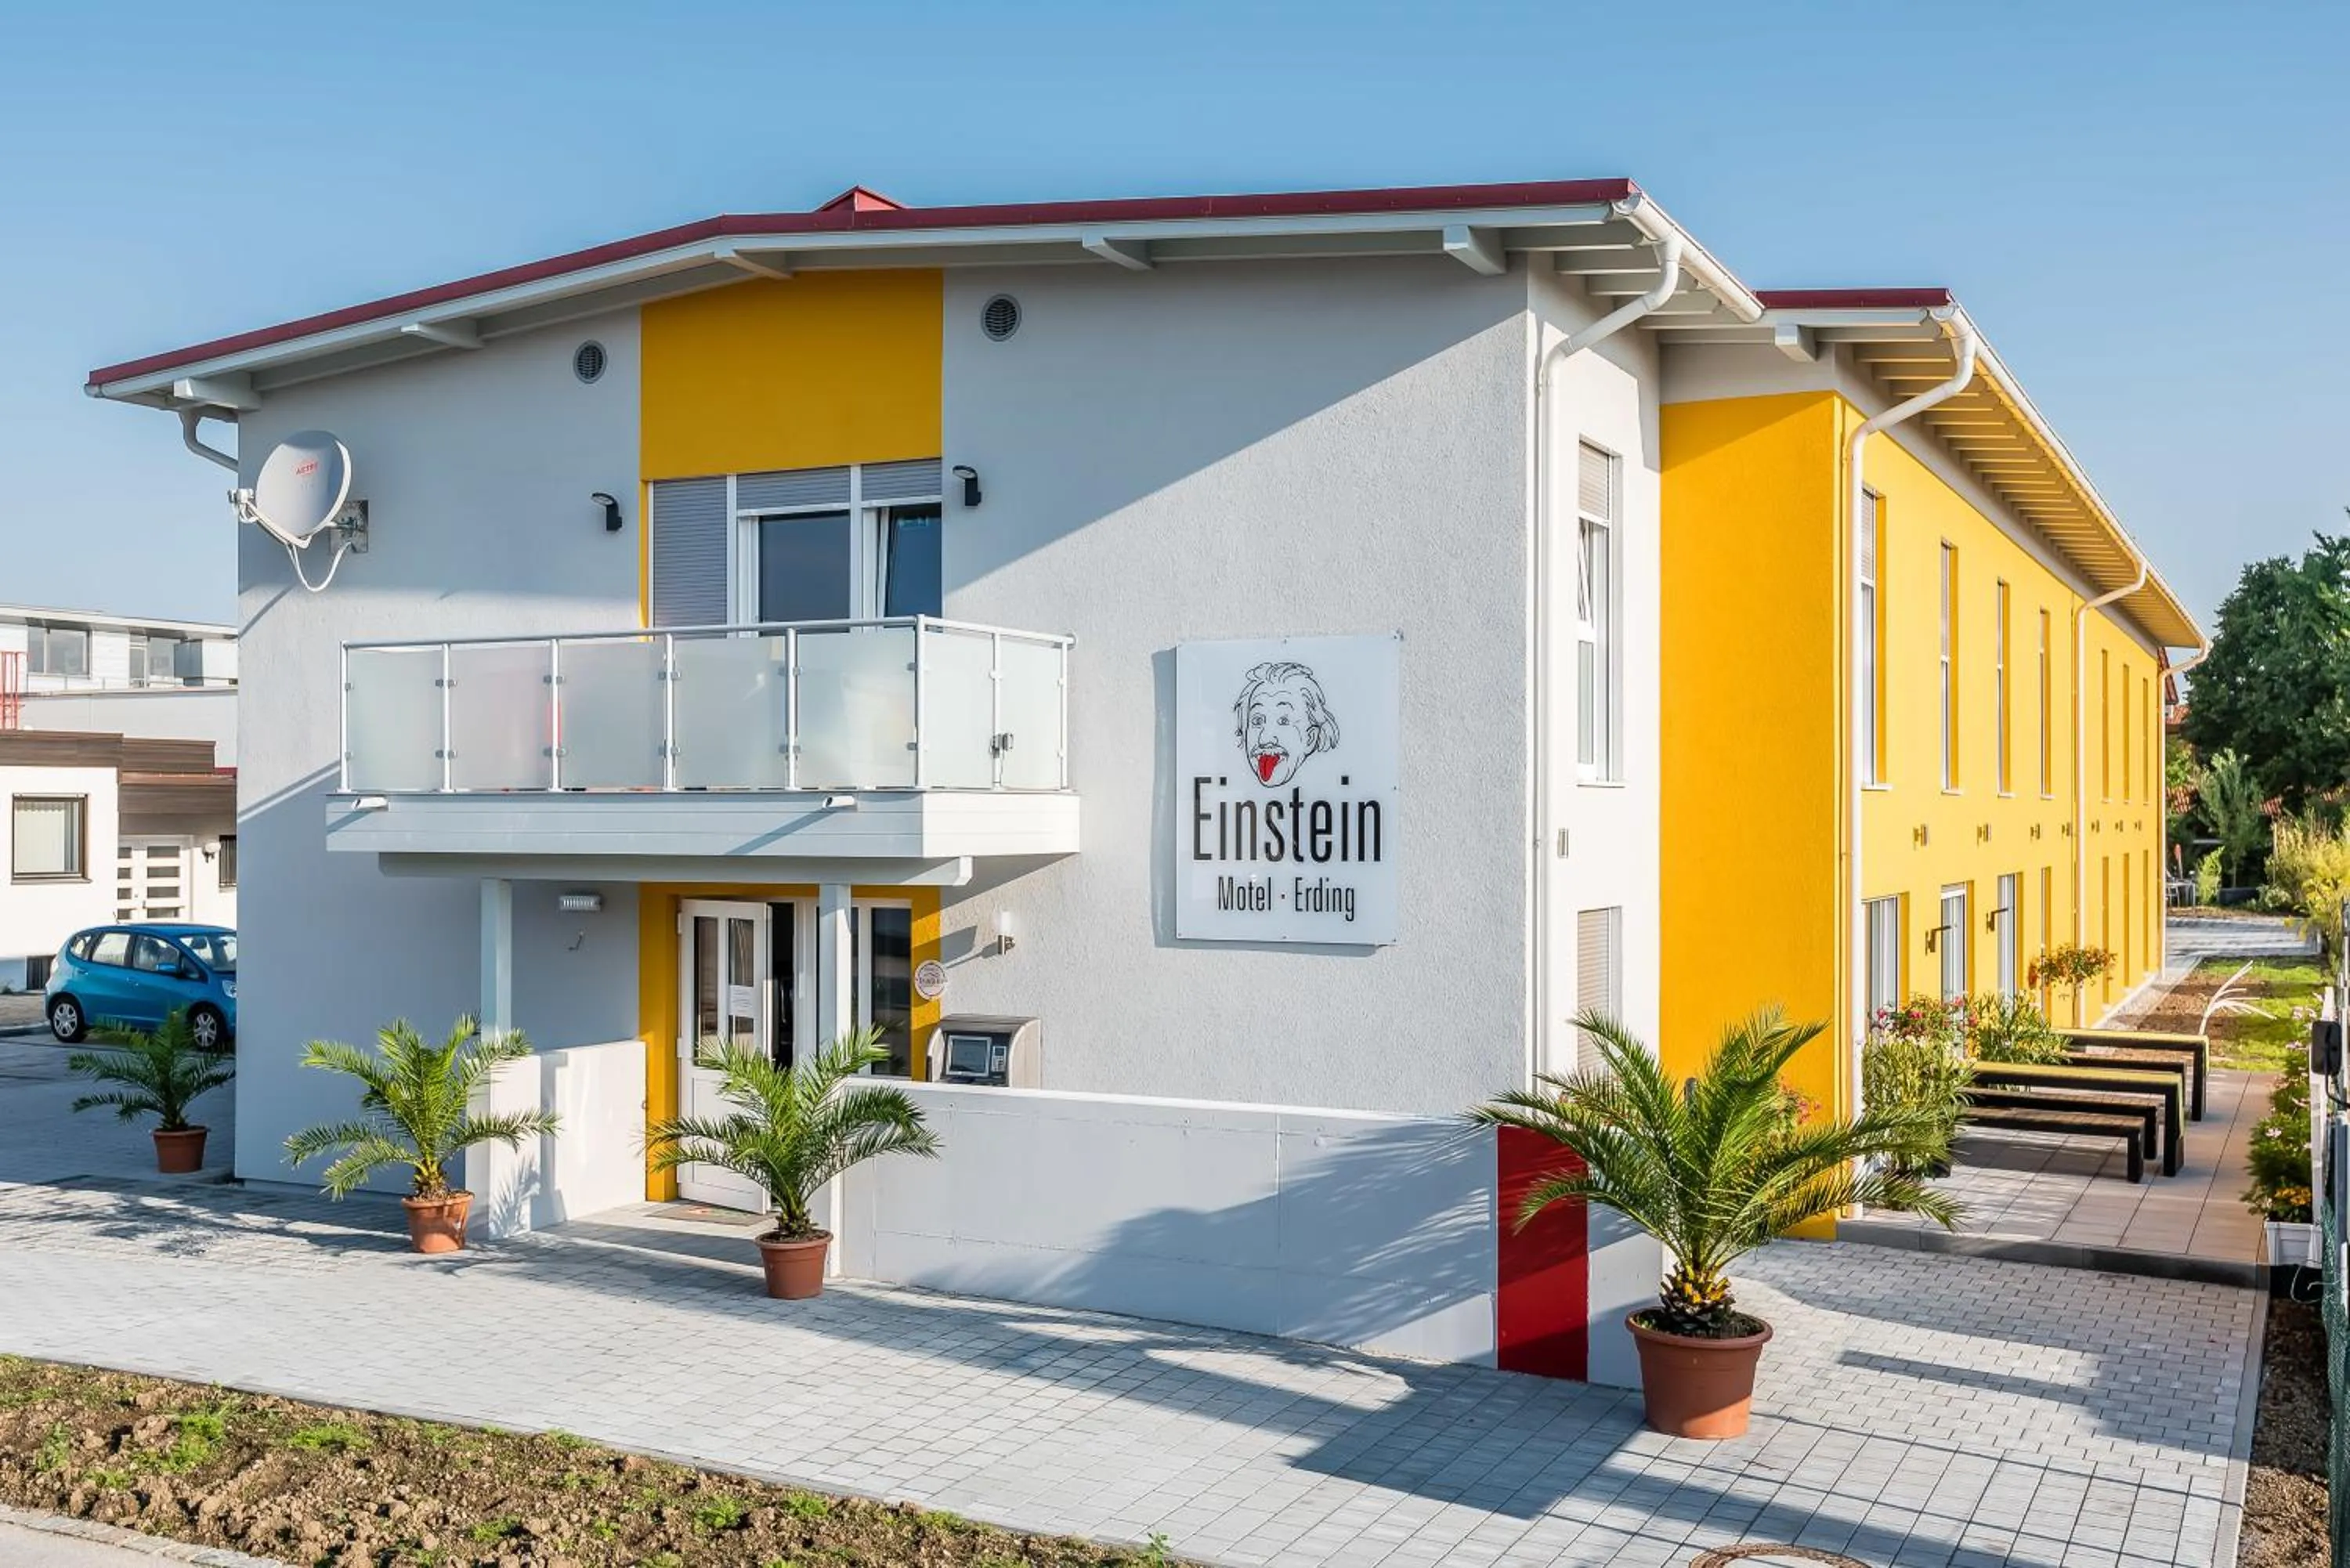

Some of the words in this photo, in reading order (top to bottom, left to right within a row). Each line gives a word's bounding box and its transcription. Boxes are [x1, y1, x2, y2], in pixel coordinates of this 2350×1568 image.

[1193, 775, 1381, 862] Einstein
[1218, 876, 1272, 911] Motel
[1295, 876, 1355, 922] Erding
